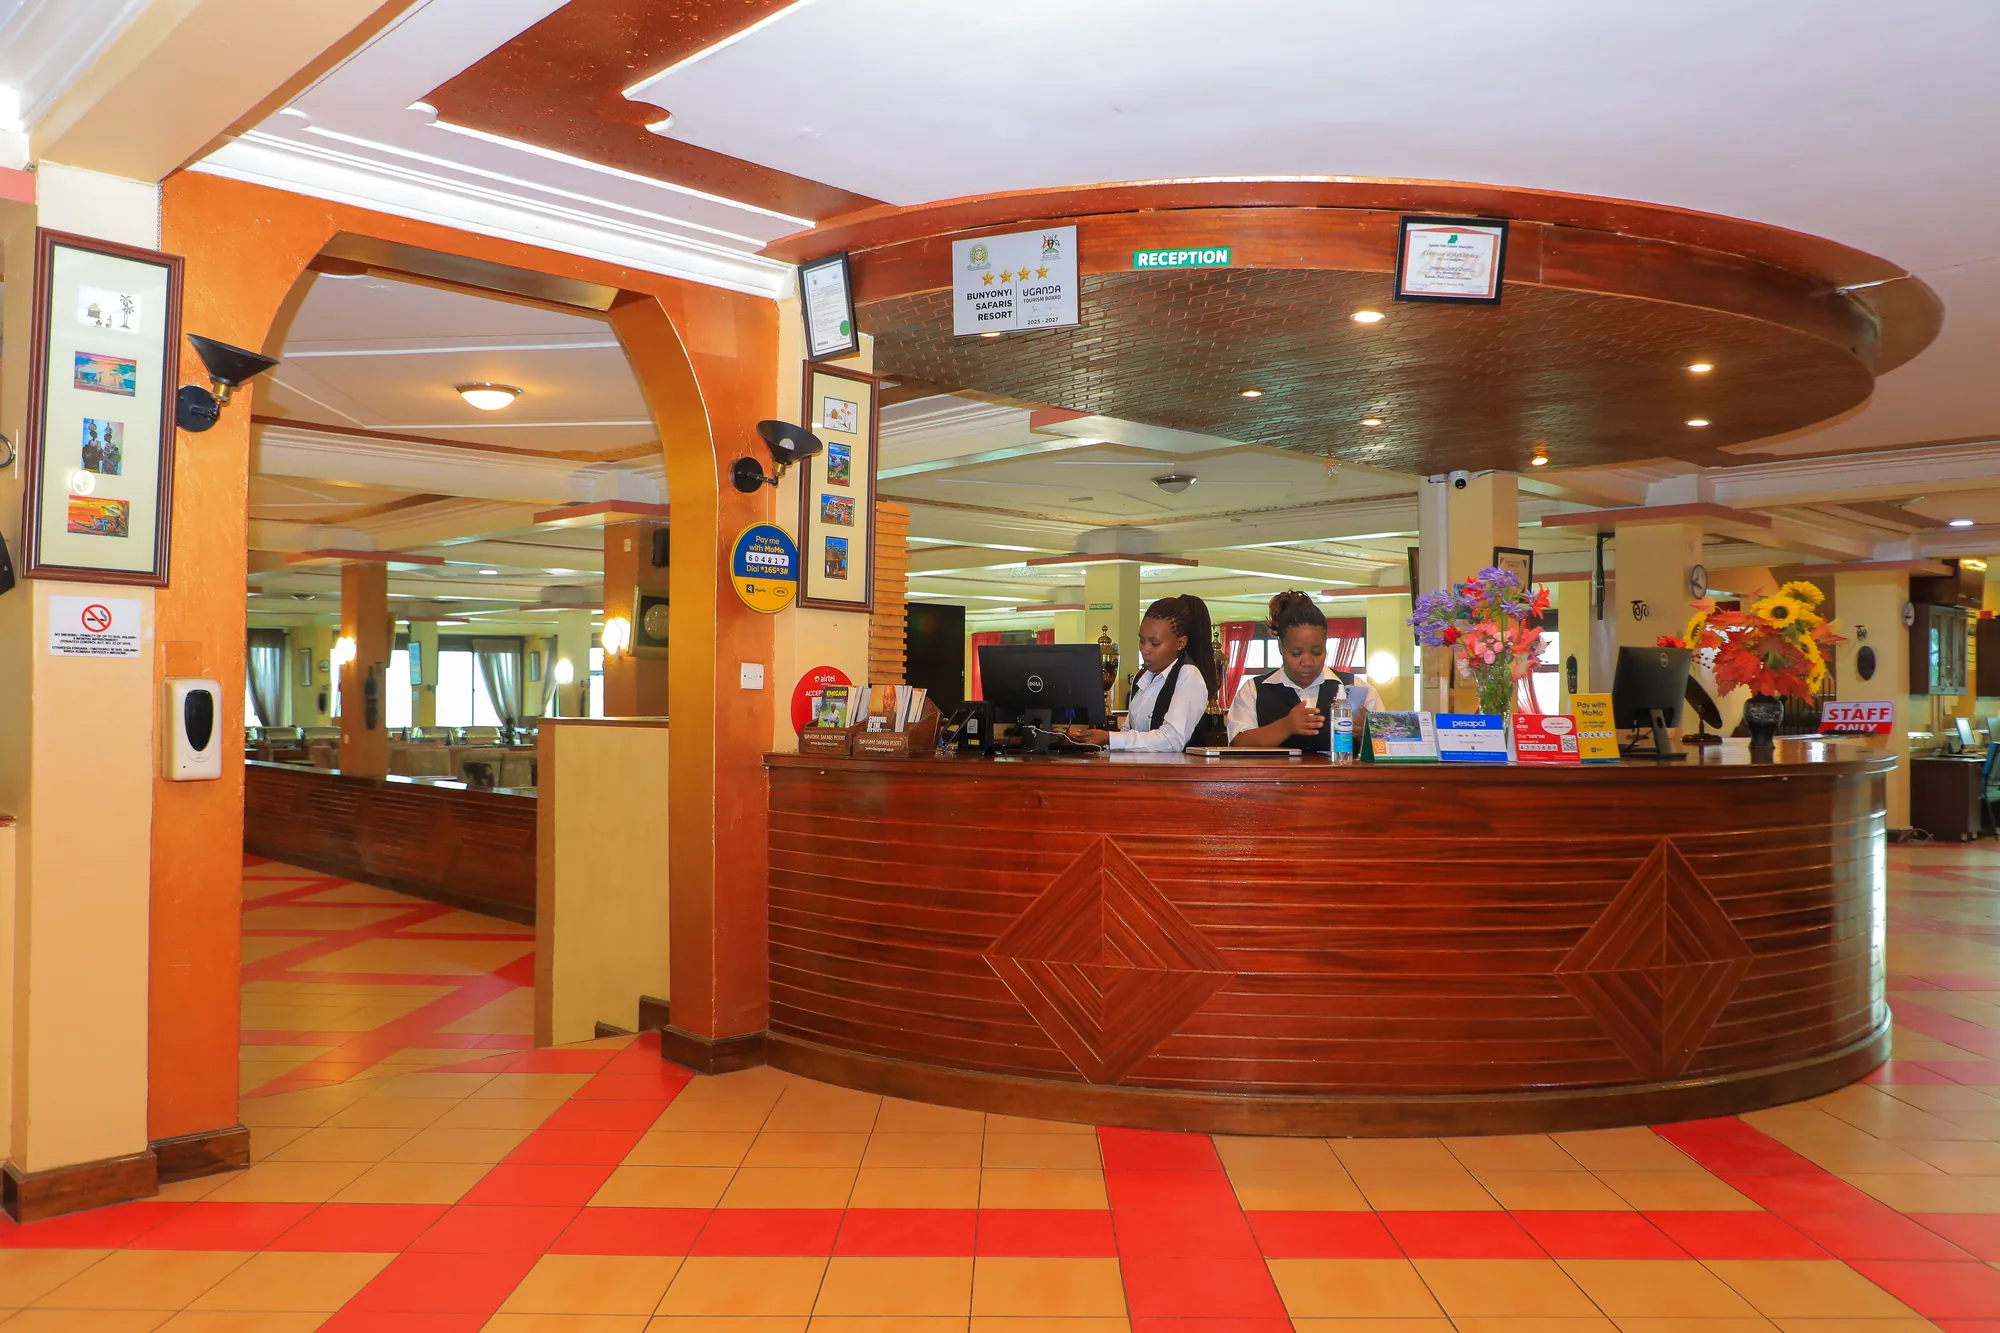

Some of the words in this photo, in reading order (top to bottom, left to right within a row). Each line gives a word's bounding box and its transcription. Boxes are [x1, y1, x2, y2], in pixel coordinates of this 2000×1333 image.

[1138, 250, 1228, 266] RECEPTION
[966, 288, 1013, 301] BUNYONYI
[1022, 285, 1061, 297] UGANDA
[1045, 294, 1062, 302] BOARD
[975, 300, 1013, 311] SAFARIS
[977, 310, 1013, 321] RESORT
[1045, 316, 1059, 324] 2027
[755, 535, 769, 545] Pay
[749, 543, 764, 552] with
[764, 545, 785, 554] MoMo
[746, 564, 760, 573] Dial
[1577, 701, 1590, 709] Pay
[1828, 708, 1890, 720] STAFF
[1452, 719, 1486, 728] pesapal
